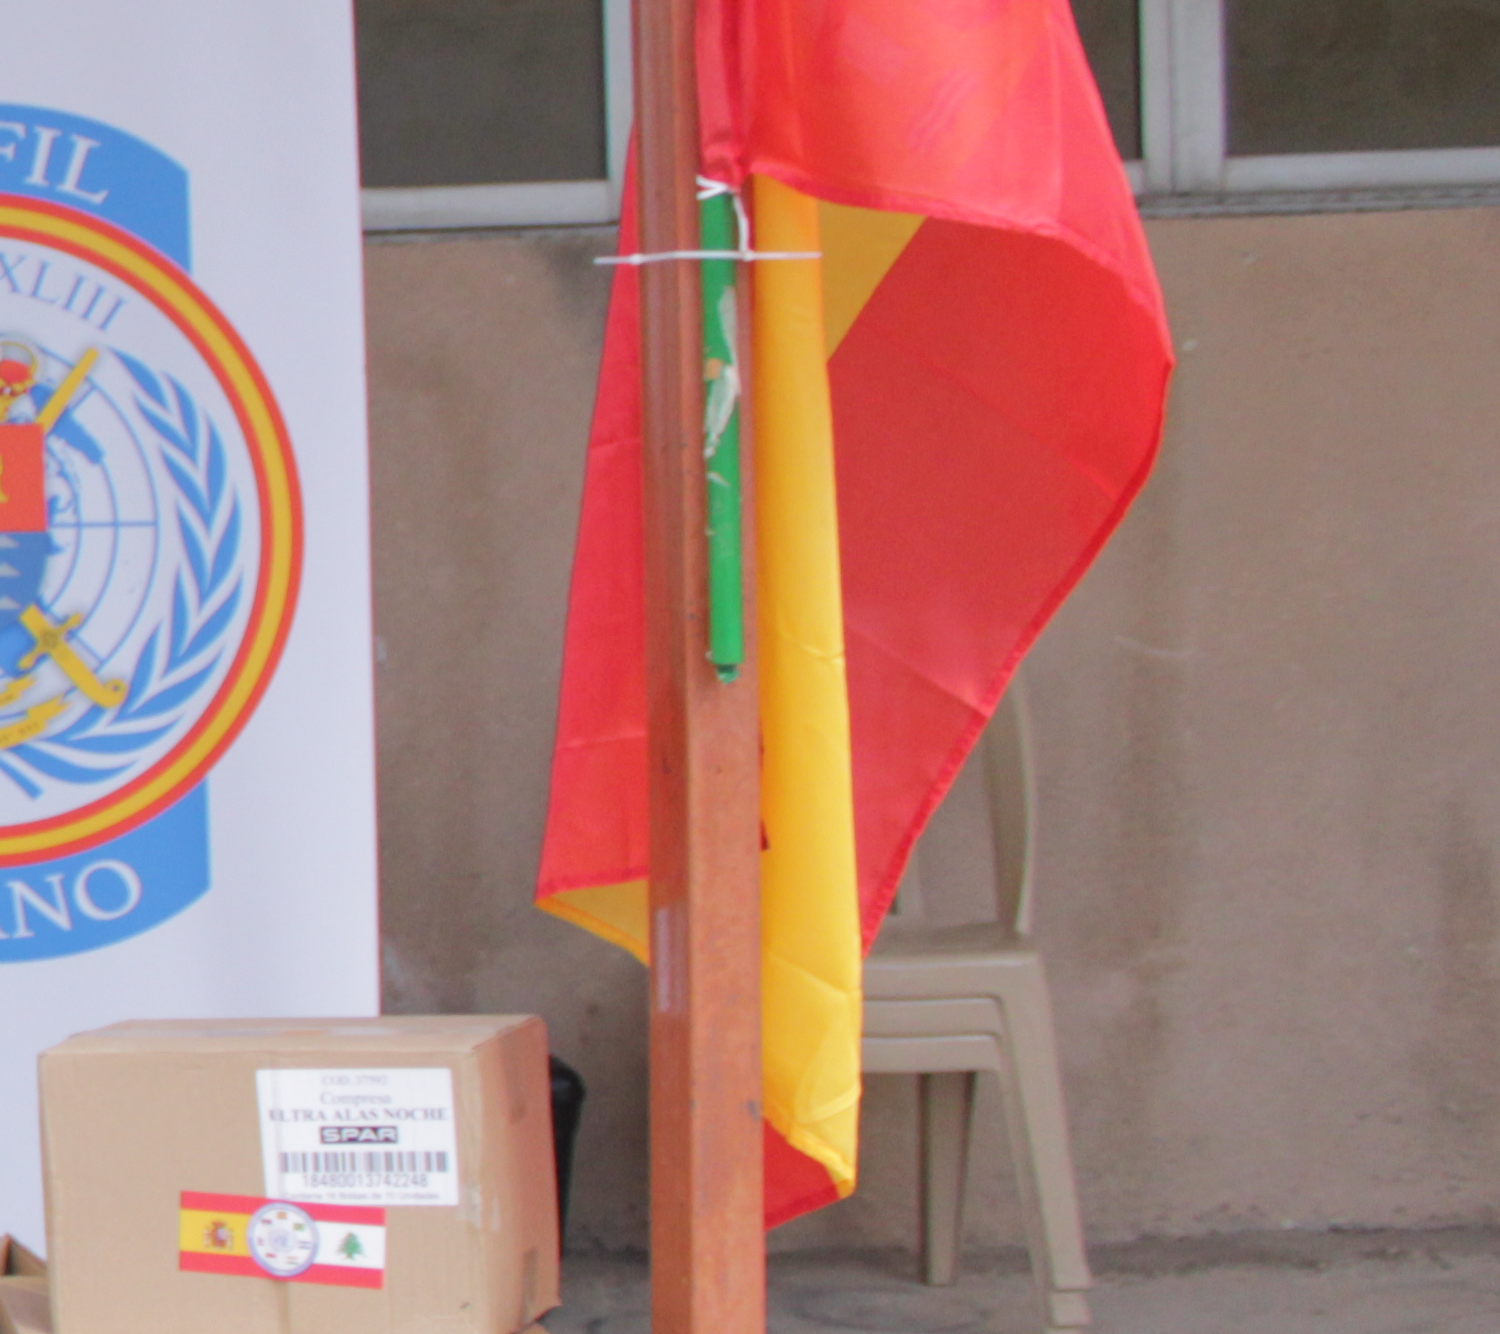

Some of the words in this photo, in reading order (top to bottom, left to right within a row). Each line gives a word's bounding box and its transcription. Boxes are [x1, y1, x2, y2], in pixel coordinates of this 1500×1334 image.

[332, 1108, 379, 1121] ALAS
[383, 1107, 449, 1121] NOCHE
[320, 1126, 397, 1144] SPAR
